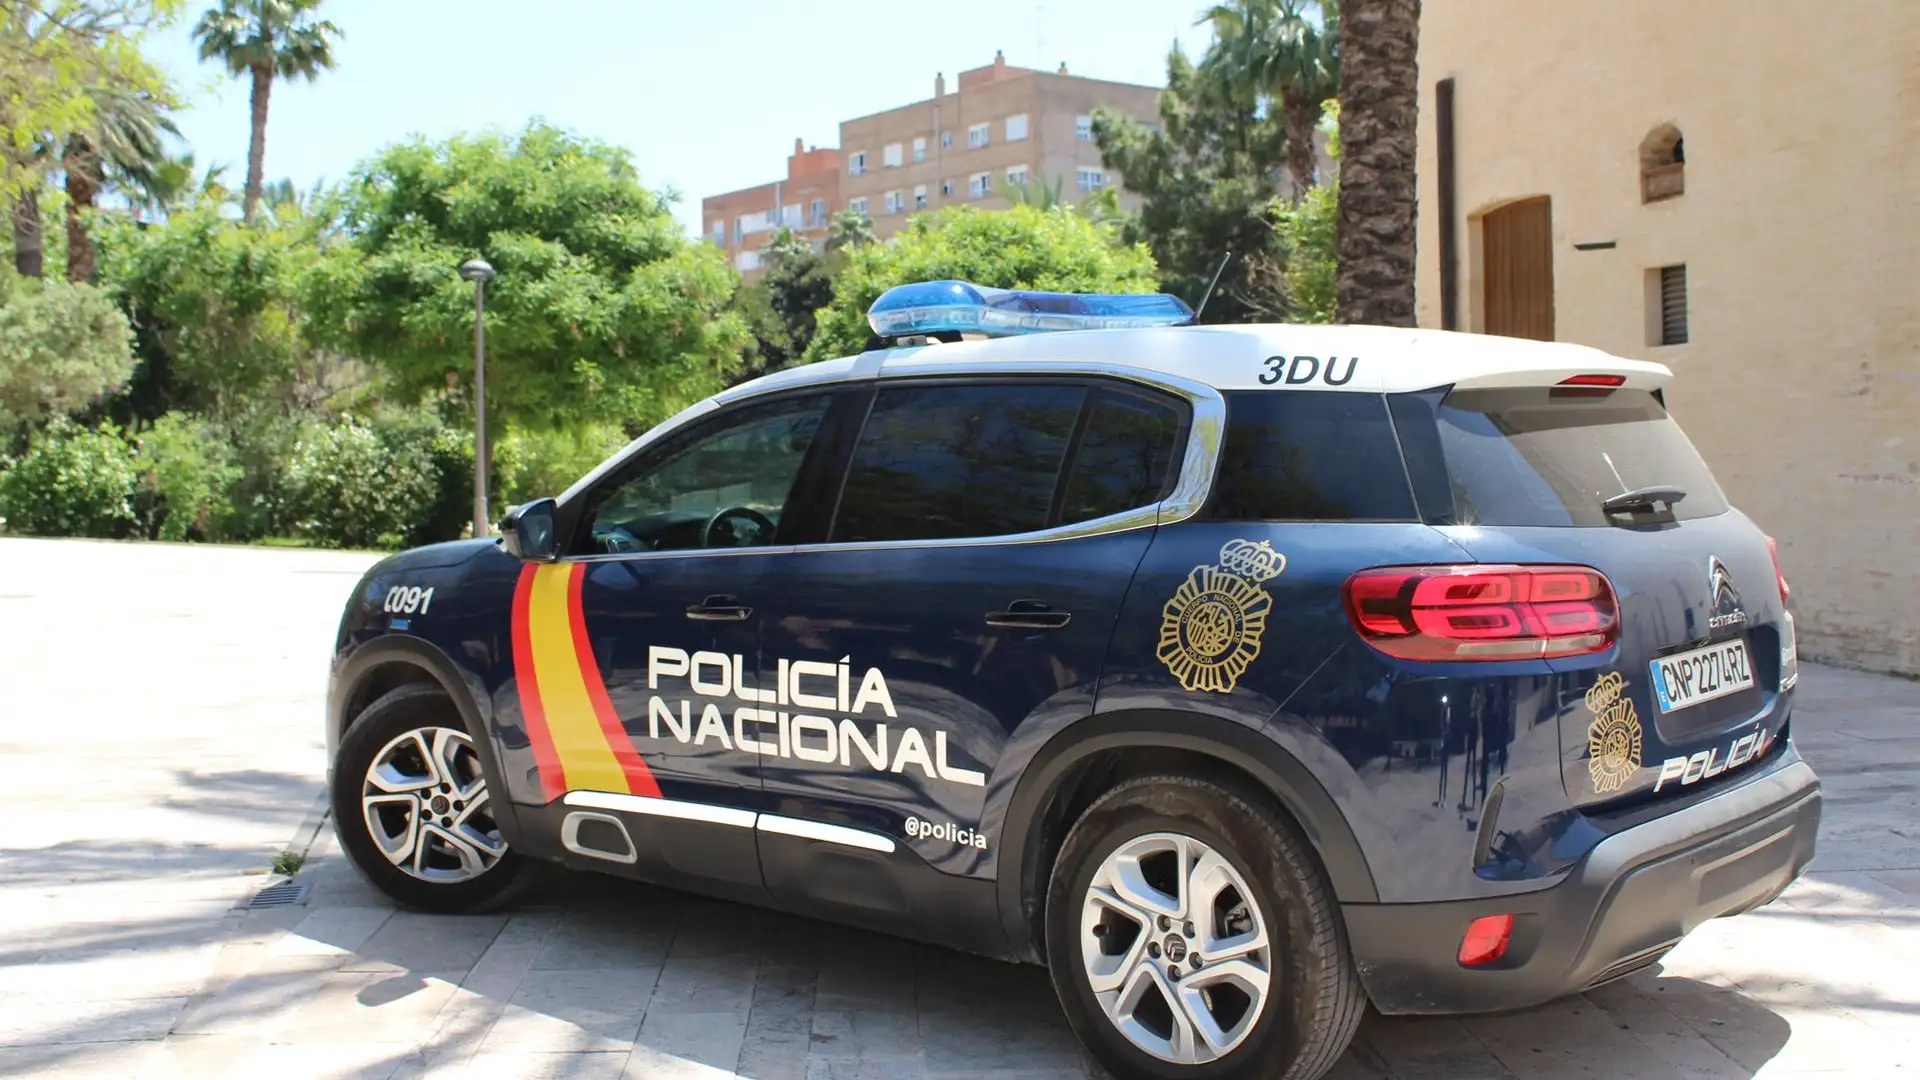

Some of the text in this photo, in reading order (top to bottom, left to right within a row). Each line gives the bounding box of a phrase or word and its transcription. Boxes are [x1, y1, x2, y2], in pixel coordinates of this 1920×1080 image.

[1258, 355, 1359, 386] 3DU
[649, 645, 898, 718] POLICÍA
[649, 695, 986, 787] NACIONAL
[904, 816, 988, 850] @policia
